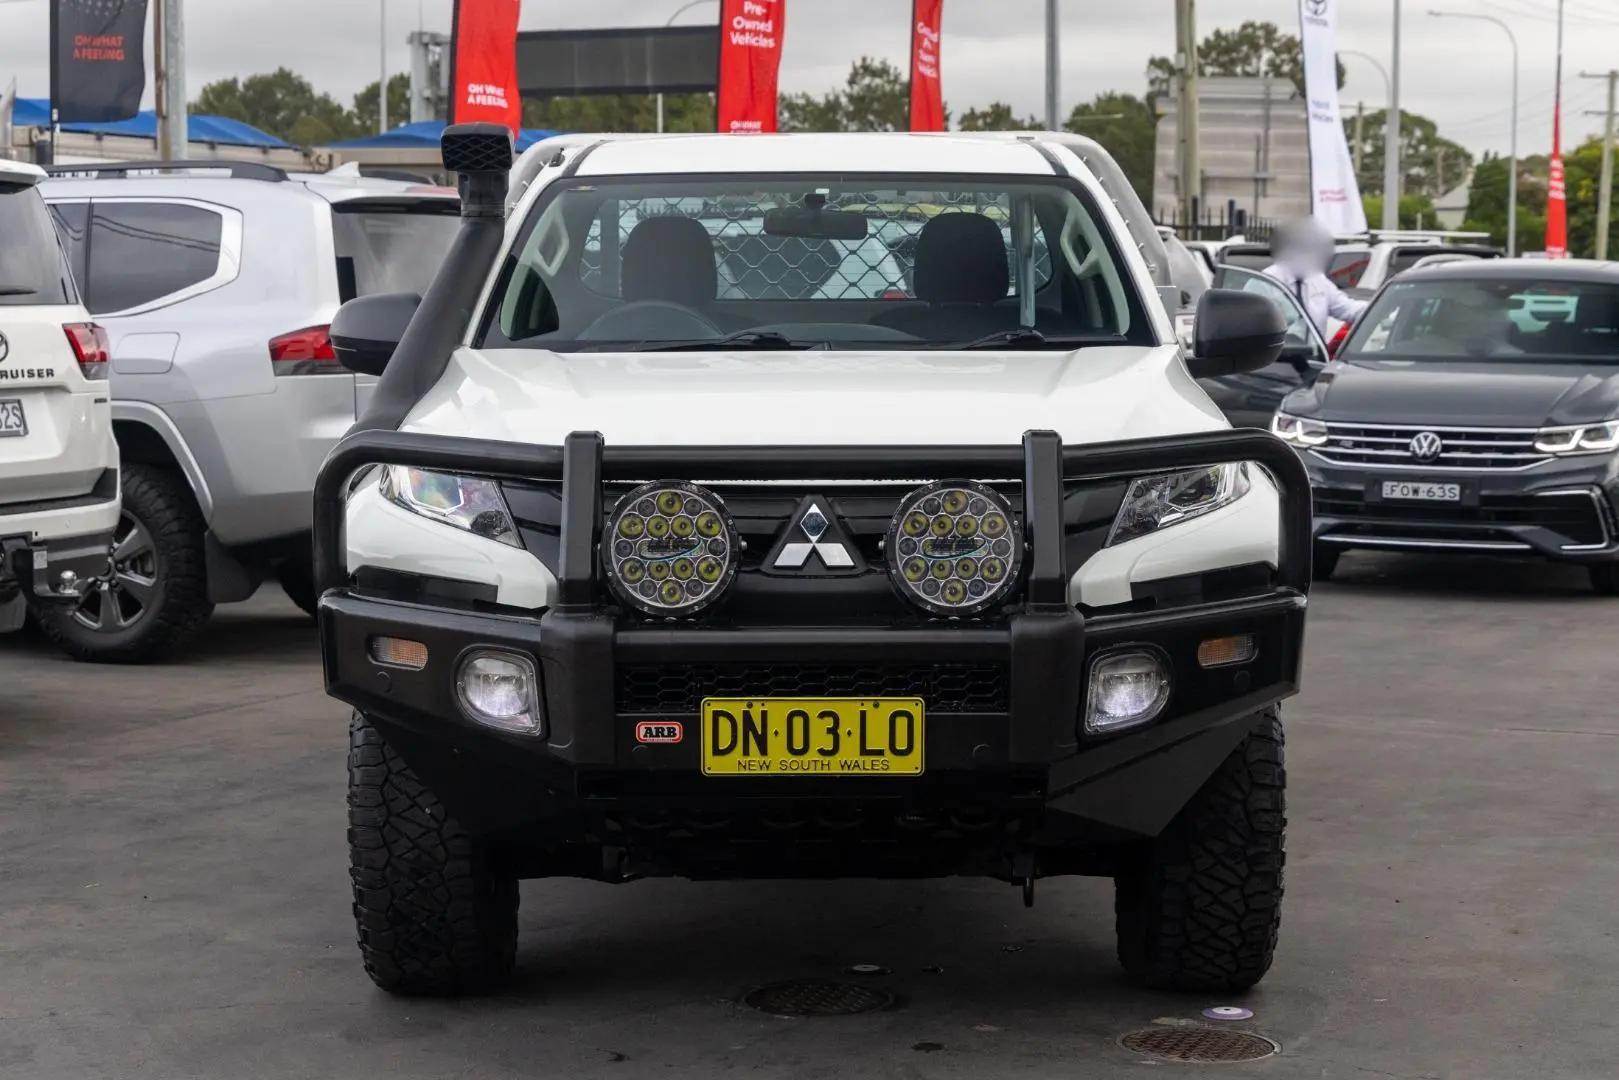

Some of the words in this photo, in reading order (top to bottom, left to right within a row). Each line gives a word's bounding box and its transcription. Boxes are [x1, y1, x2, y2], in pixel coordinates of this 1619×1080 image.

[743, 0, 767, 16] Pre-
[732, 16, 773, 33] Owned
[729, 31, 776, 48] Vehicles
[73, 48, 80, 59] A
[467, 83, 484, 94] OH
[467, 94, 475, 104] A
[642, 726, 678, 738] ARB
[737, 759, 771, 771] NEW
[779, 759, 831, 771] SOUTH
[838, 759, 890, 771] WALES
